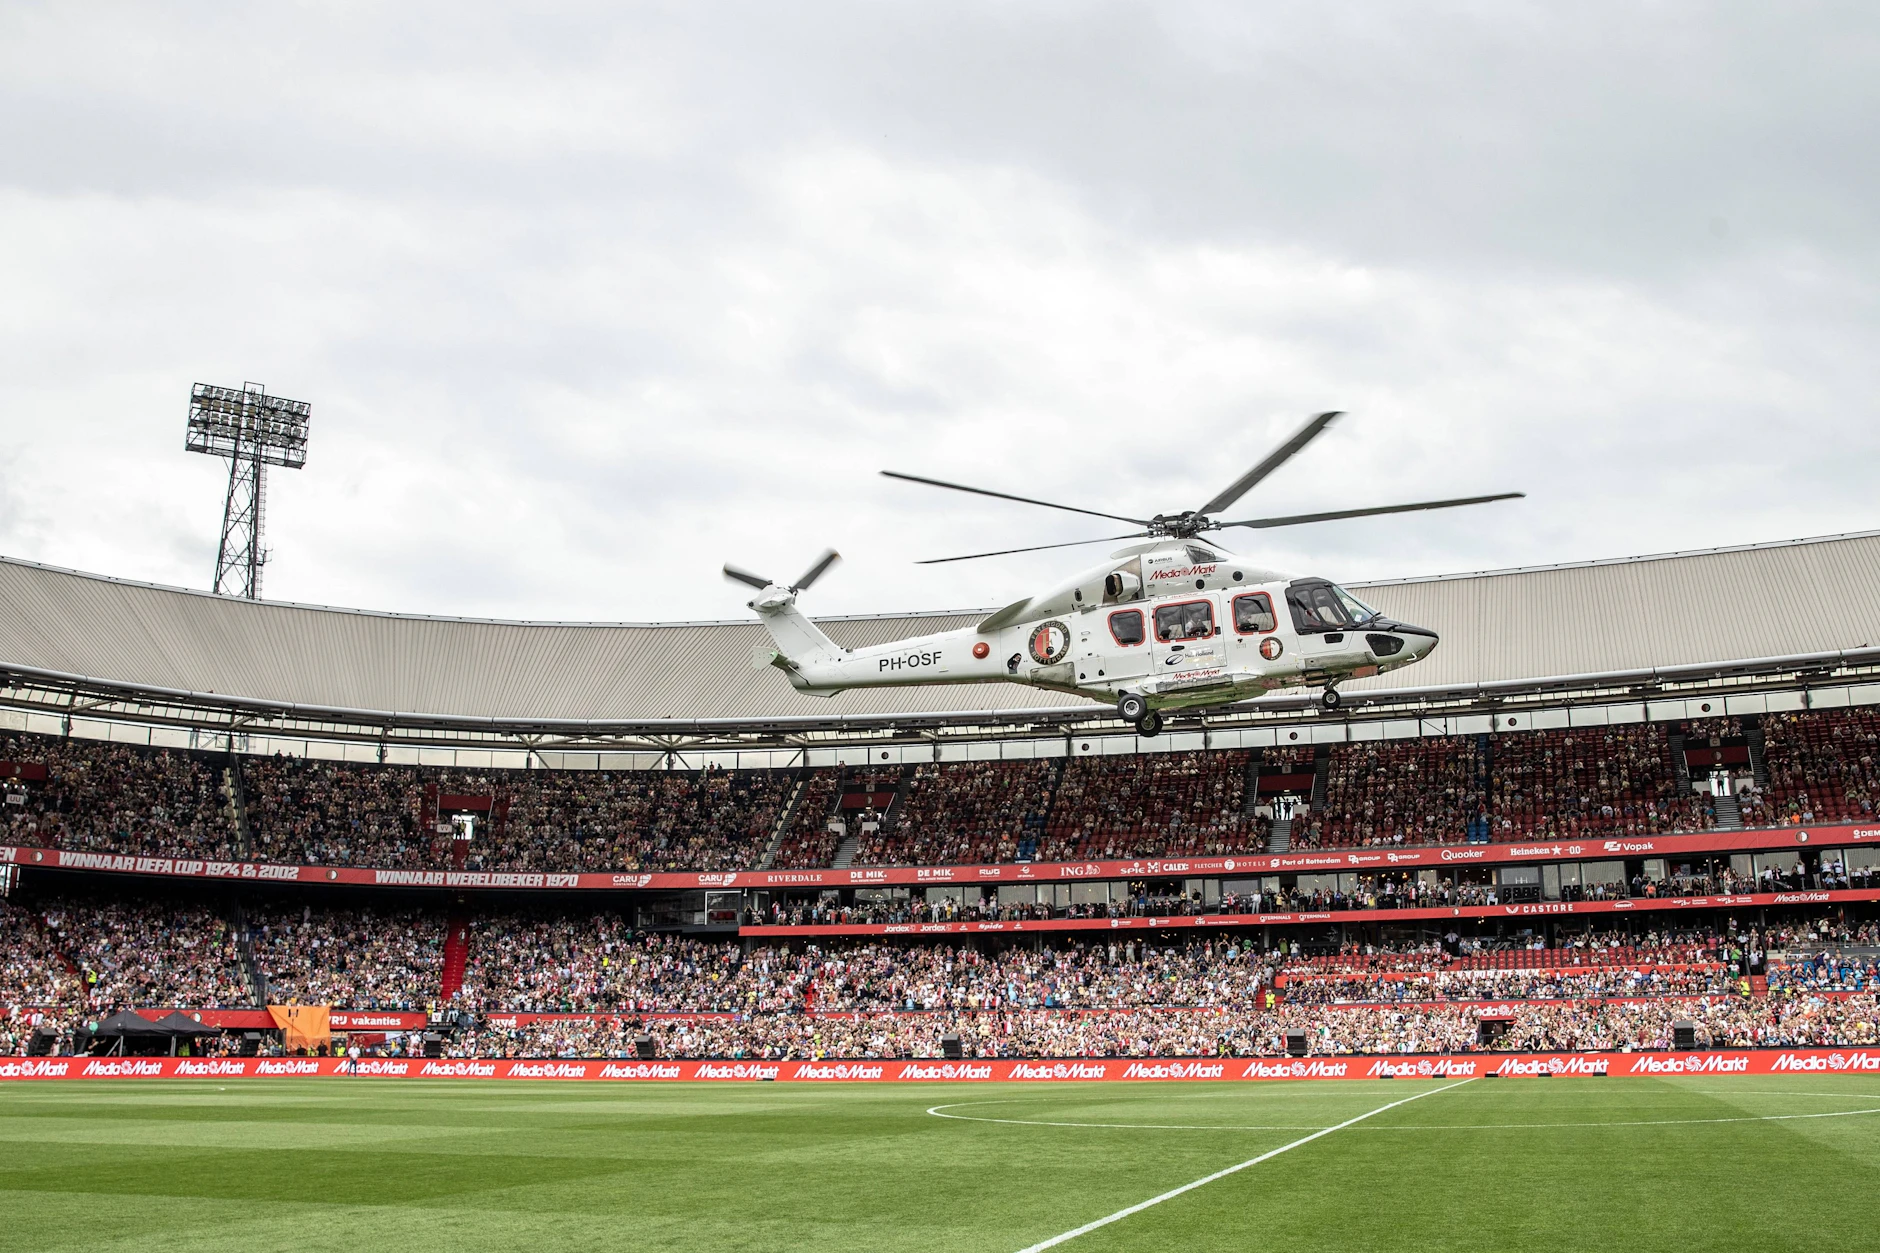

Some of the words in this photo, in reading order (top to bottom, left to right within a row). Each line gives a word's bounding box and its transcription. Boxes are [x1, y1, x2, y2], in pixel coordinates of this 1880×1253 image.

[878, 651, 942, 672] PH-OSF
[1510, 847, 1550, 856] Heineken
[1623, 842, 1654, 851] Vopak
[1441, 850, 1484, 860] Quooker
[60, 852, 135, 870] WINNAAR
[136, 858, 173, 874] UEFA
[174, 860, 204, 874] CUP
[205, 862, 240, 876] 1974
[242, 864, 257, 878] &
[258, 865, 300, 880] 2002
[1061, 866, 1084, 876] ING
[375, 870, 444, 884] WINNAAR
[446, 872, 544, 886] WERELDBEKER
[546, 874, 580, 887] 1970
[1524, 904, 1574, 913] CASTORE
[884, 924, 910, 932] Jordex
[920, 924, 946, 932] Jordex
[352, 1014, 401, 1026] vakanties
